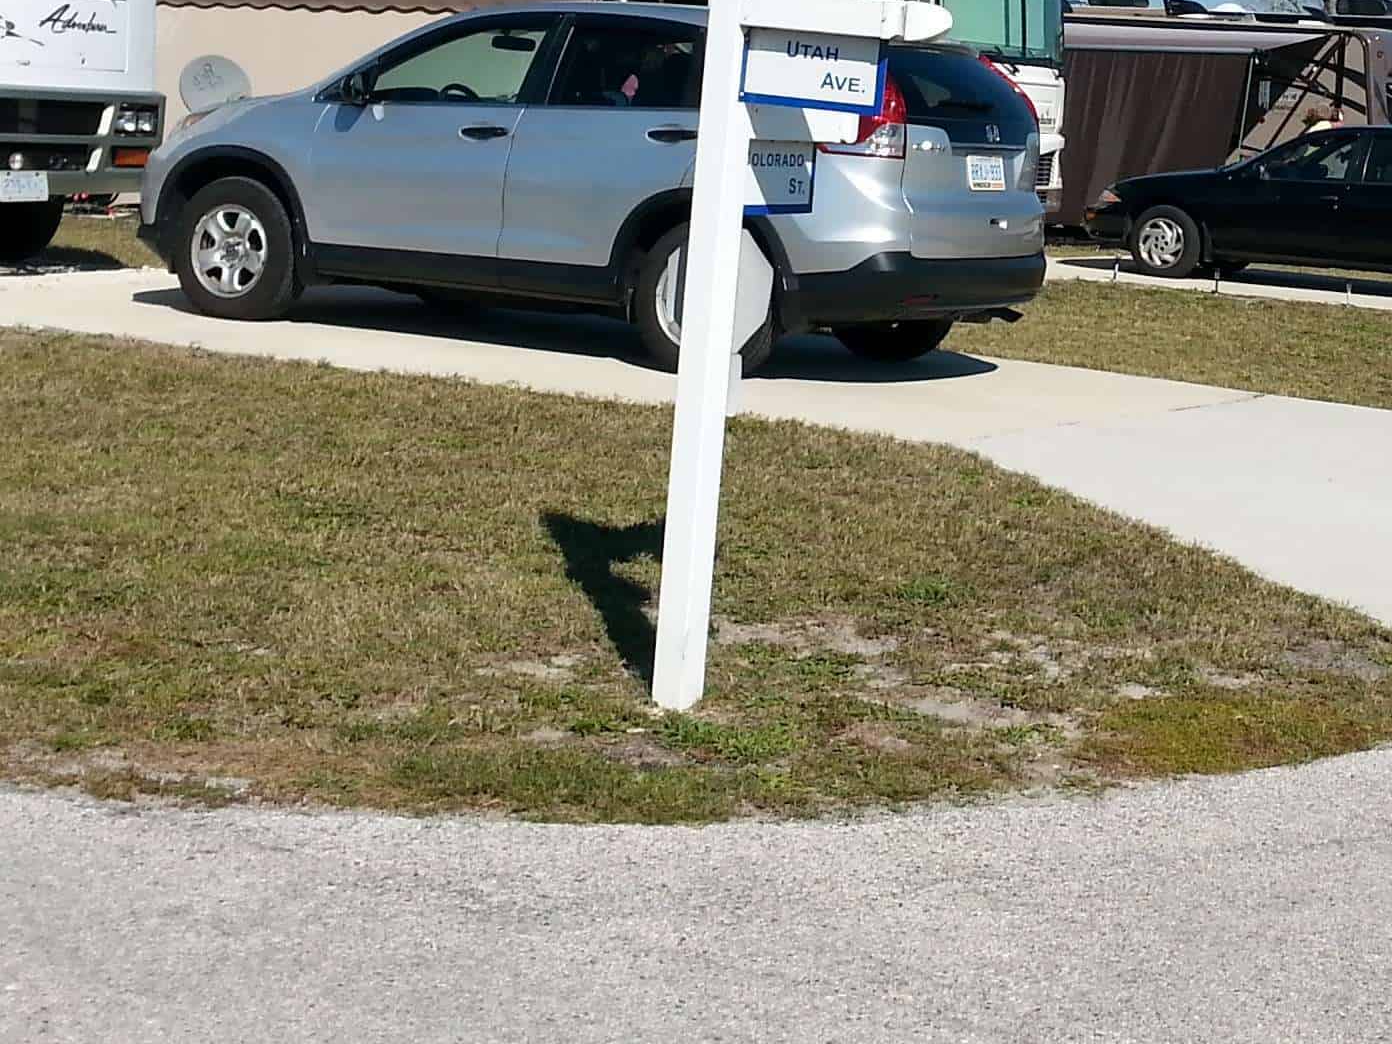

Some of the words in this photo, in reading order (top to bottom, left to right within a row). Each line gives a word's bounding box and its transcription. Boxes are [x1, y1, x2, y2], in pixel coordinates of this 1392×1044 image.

[786, 40, 840, 62] UTAH
[820, 72, 866, 94] AVE.
[750, 152, 805, 168] OLORADO
[788, 177, 806, 196] ST.
